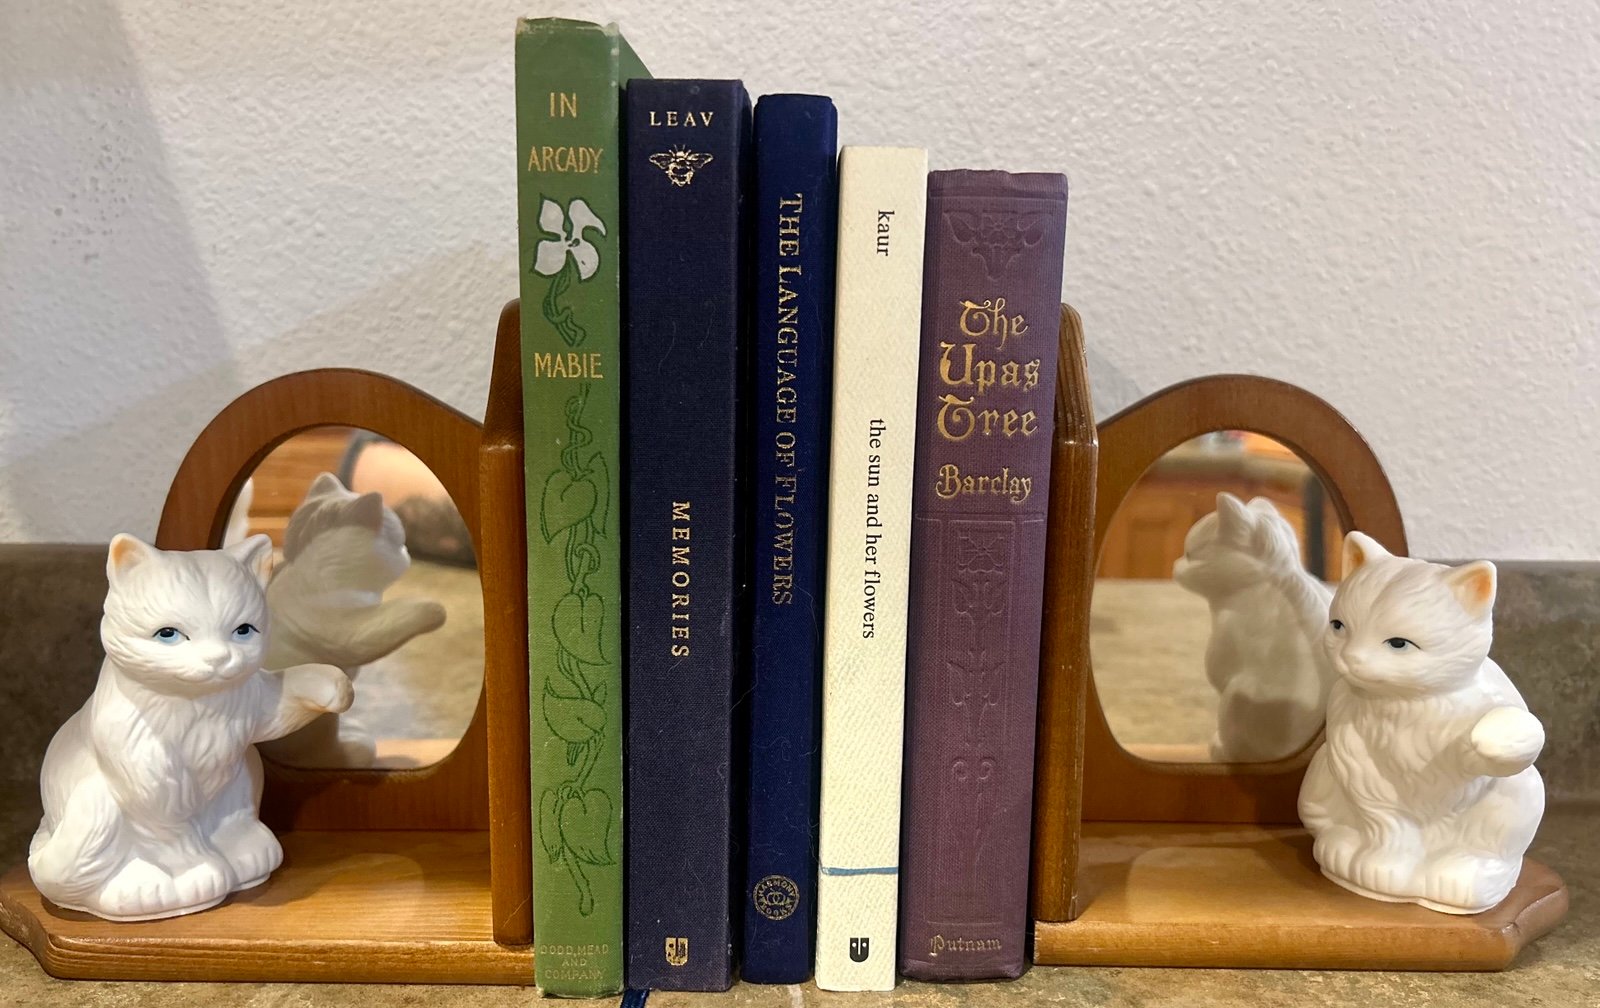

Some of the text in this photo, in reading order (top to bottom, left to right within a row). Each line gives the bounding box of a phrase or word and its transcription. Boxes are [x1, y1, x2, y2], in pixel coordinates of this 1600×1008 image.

[549, 91, 577, 118] IN
[649, 111, 715, 127] LEAV
[527, 145, 604, 174] ARCADY
[876, 209, 895, 257] kaur
[959, 297, 1029, 351] The
[533, 352, 605, 379] MABIE
[939, 341, 1041, 396] Upas
[772, 192, 803, 605] THE LANGUAGE OF FLOWERS
[936, 393, 1039, 441] Tree
[935, 463, 1033, 505] Barclay
[862, 418, 887, 639] the sun and her flowers
[671, 501, 691, 657] MEMORIES
[757, 880, 797, 898] HARMONY
[561, 958, 587, 967] AND
[929, 933, 1003, 957] Putnam
[544, 968, 607, 981] COMPANY
